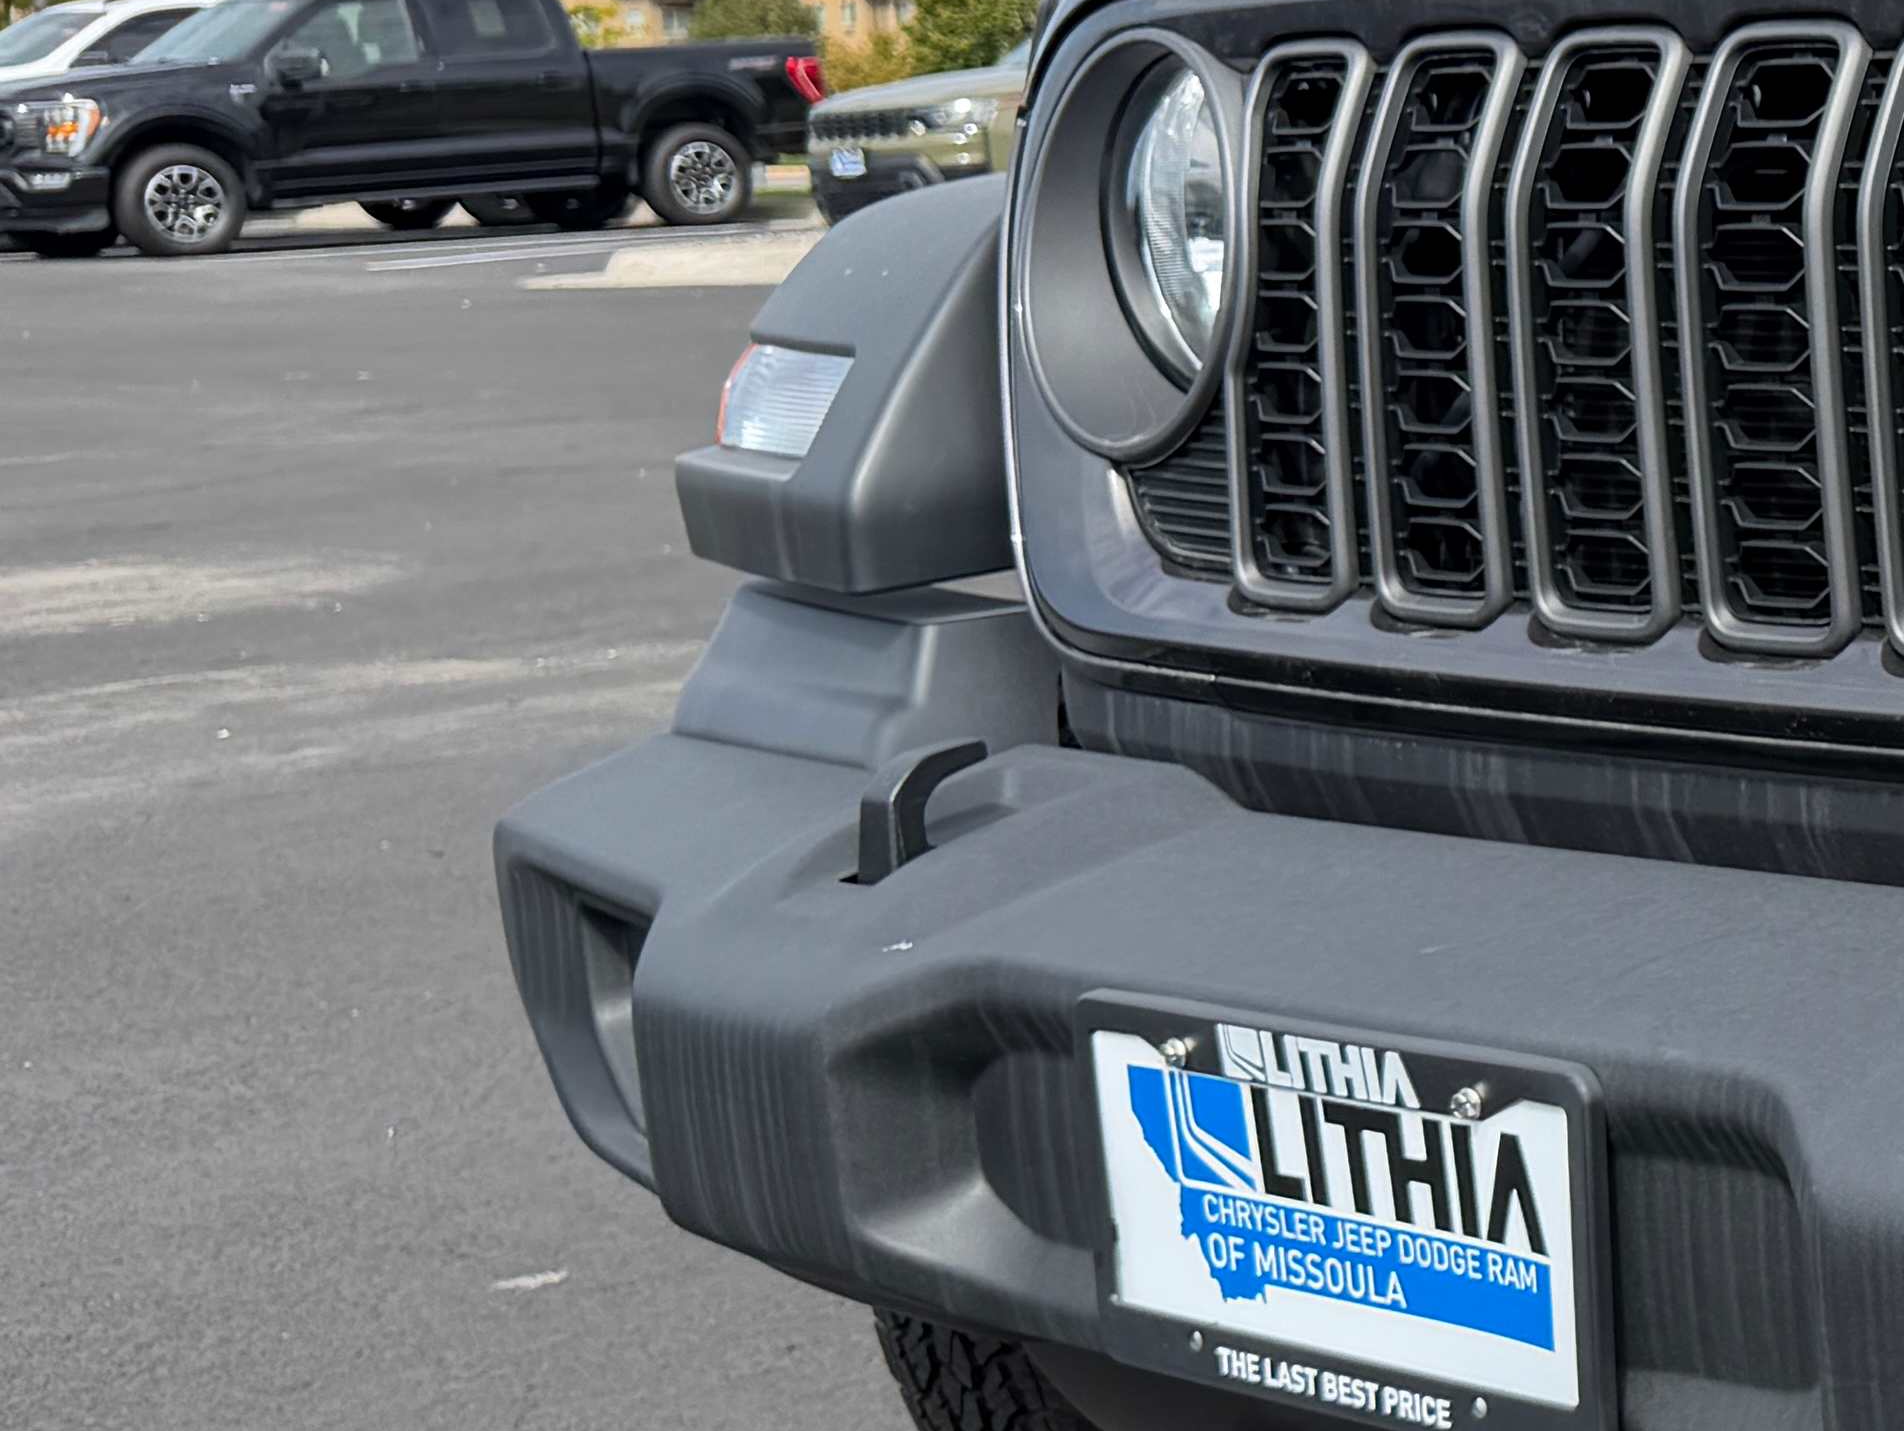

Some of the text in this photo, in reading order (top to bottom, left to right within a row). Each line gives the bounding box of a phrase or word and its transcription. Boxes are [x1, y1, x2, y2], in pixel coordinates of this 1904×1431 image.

[1258, 1029, 1421, 1110] LITHIA
[1250, 1085, 1550, 1258] LITHIA
[1203, 1193, 1538, 1295] CHRYSLER JEEP DODGE RAM
[1207, 1231, 1408, 1309] OF MISSOULA
[1214, 1346, 1453, 1431] THE LAST BEST PRICE
